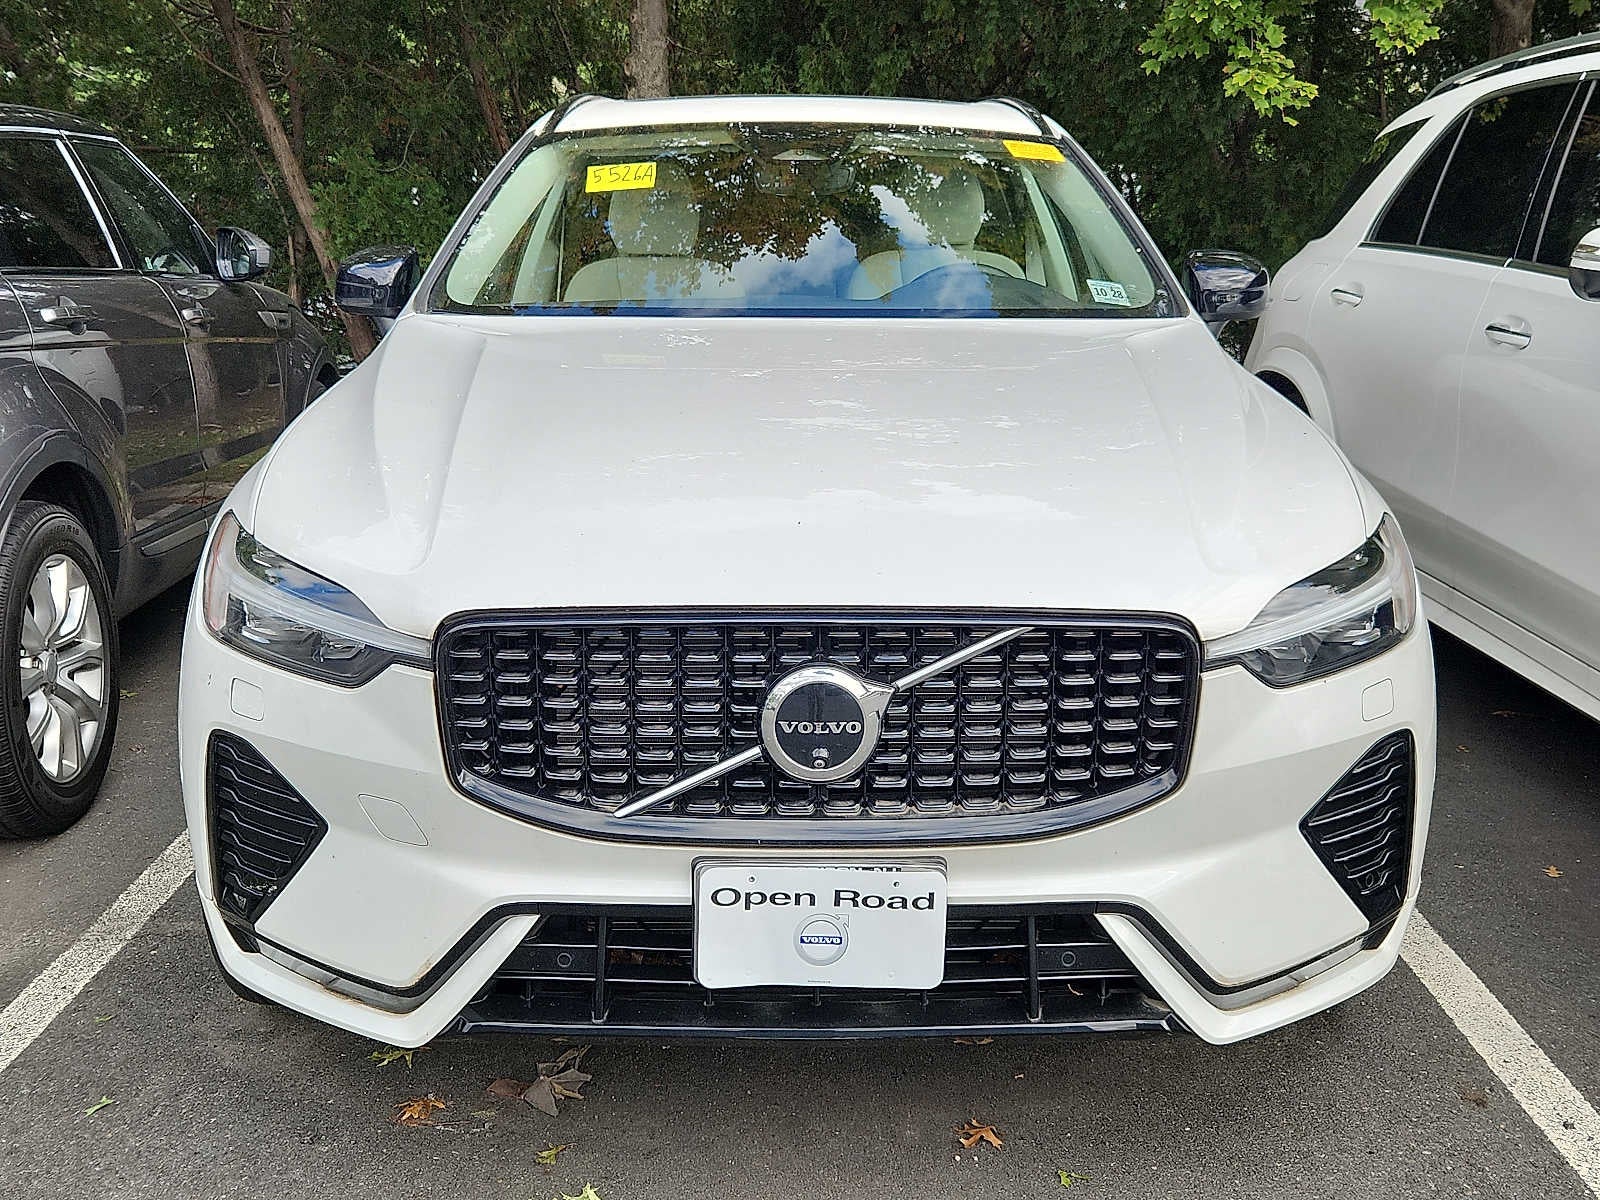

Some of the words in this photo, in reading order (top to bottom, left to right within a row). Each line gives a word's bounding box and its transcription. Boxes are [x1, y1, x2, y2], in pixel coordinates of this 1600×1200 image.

[1094, 287, 1107, 297] 10
[778, 721, 862, 734] VOLVO
[710, 887, 816, 910] Open
[833, 889, 935, 910] Road
[802, 936, 841, 944] VOLVO
